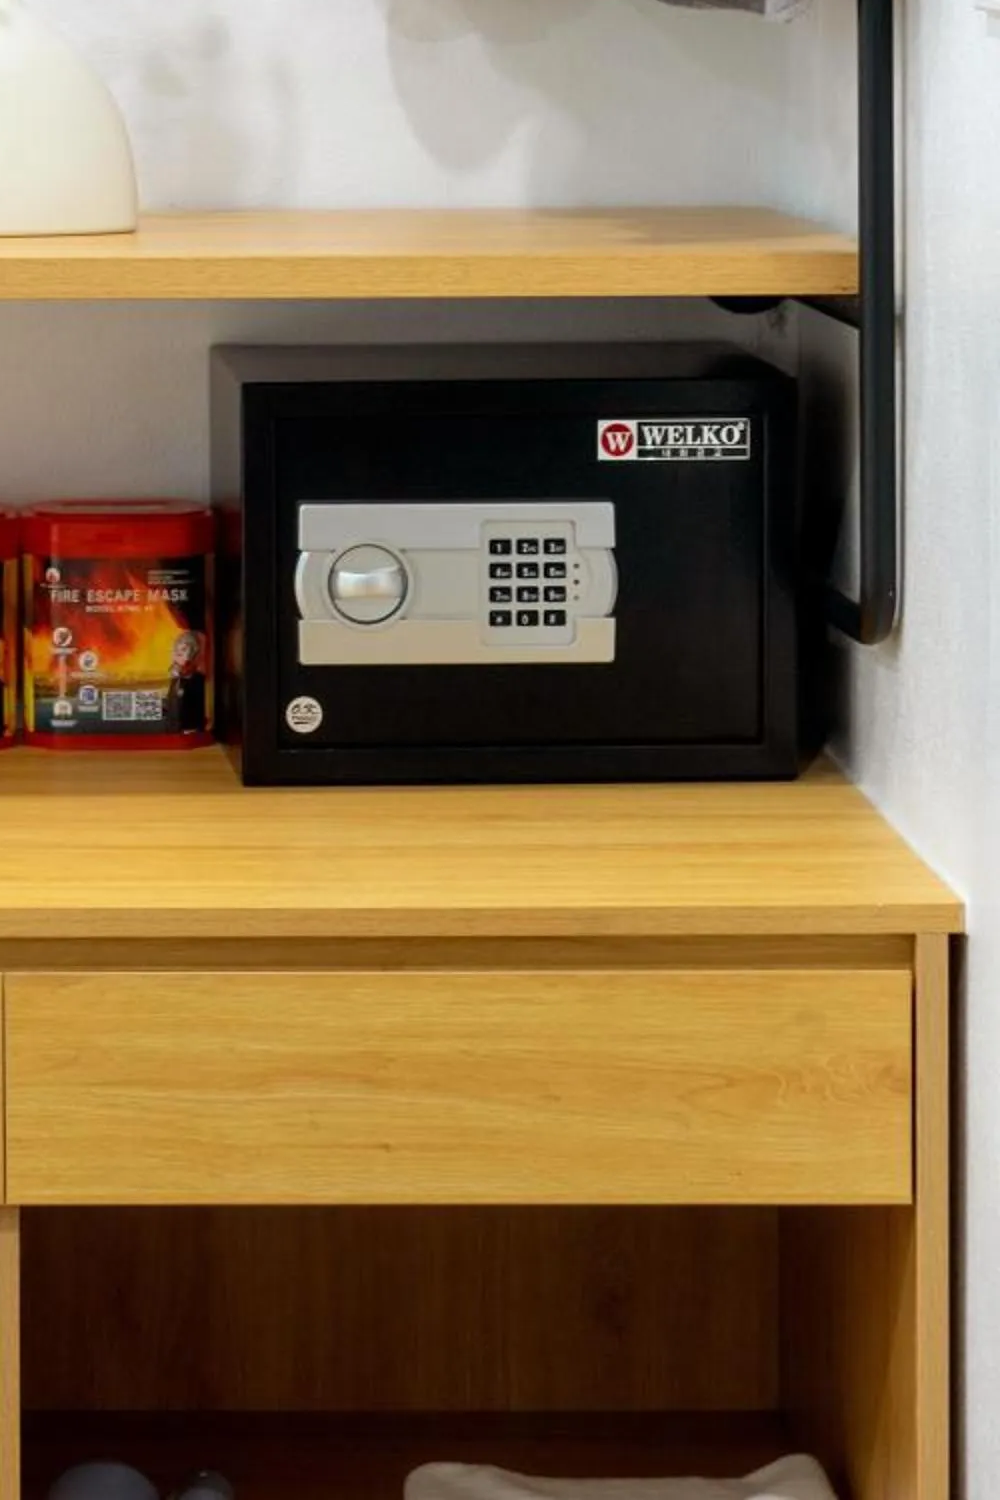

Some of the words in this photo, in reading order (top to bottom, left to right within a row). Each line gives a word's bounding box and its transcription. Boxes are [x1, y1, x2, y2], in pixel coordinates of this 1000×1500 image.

[640, 424, 741, 446] WELKO
[49, 589, 80, 603] FIRE
[86, 589, 141, 603] ESCAPE
[147, 588, 189, 602] MASK
